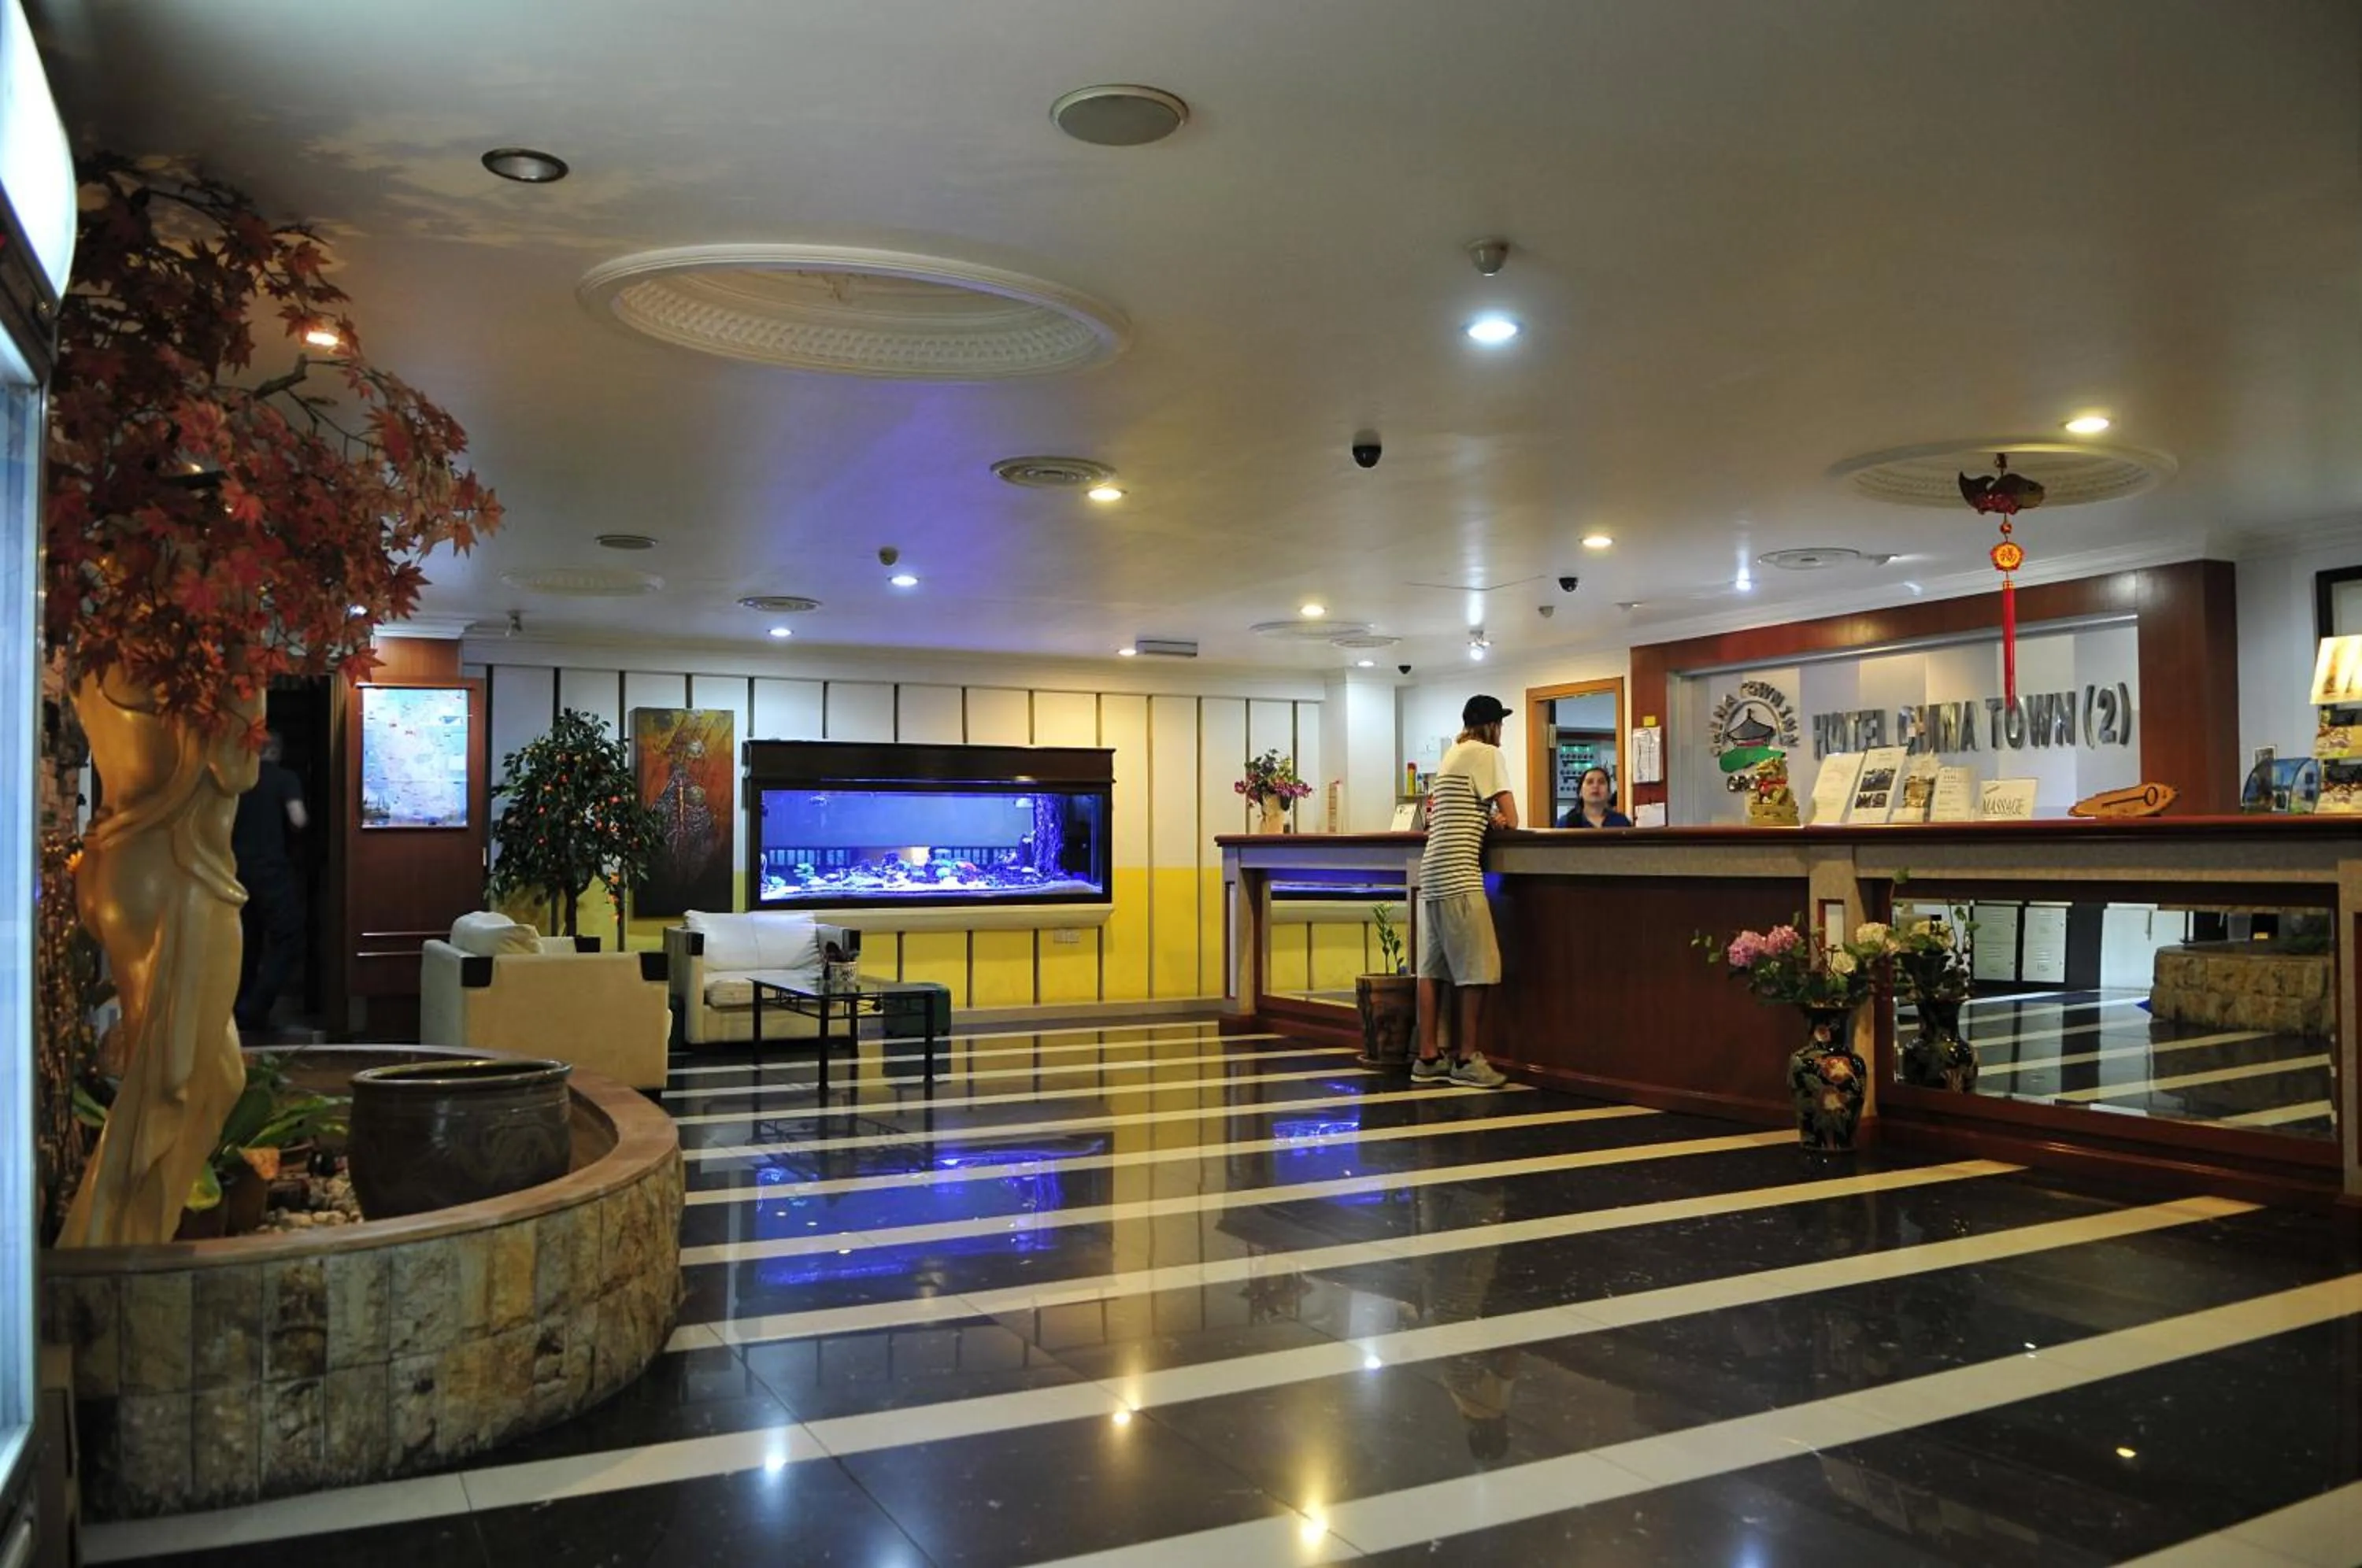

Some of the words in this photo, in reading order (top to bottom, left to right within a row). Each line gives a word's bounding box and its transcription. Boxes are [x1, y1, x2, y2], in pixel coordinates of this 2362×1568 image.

[1740, 680, 1786, 708] TOWN
[1812, 708, 1886, 761] HOTEL
[1897, 701, 1980, 756] CHINA
[1985, 691, 2076, 750] TOWN
[2082, 682, 2131, 749] (2)
